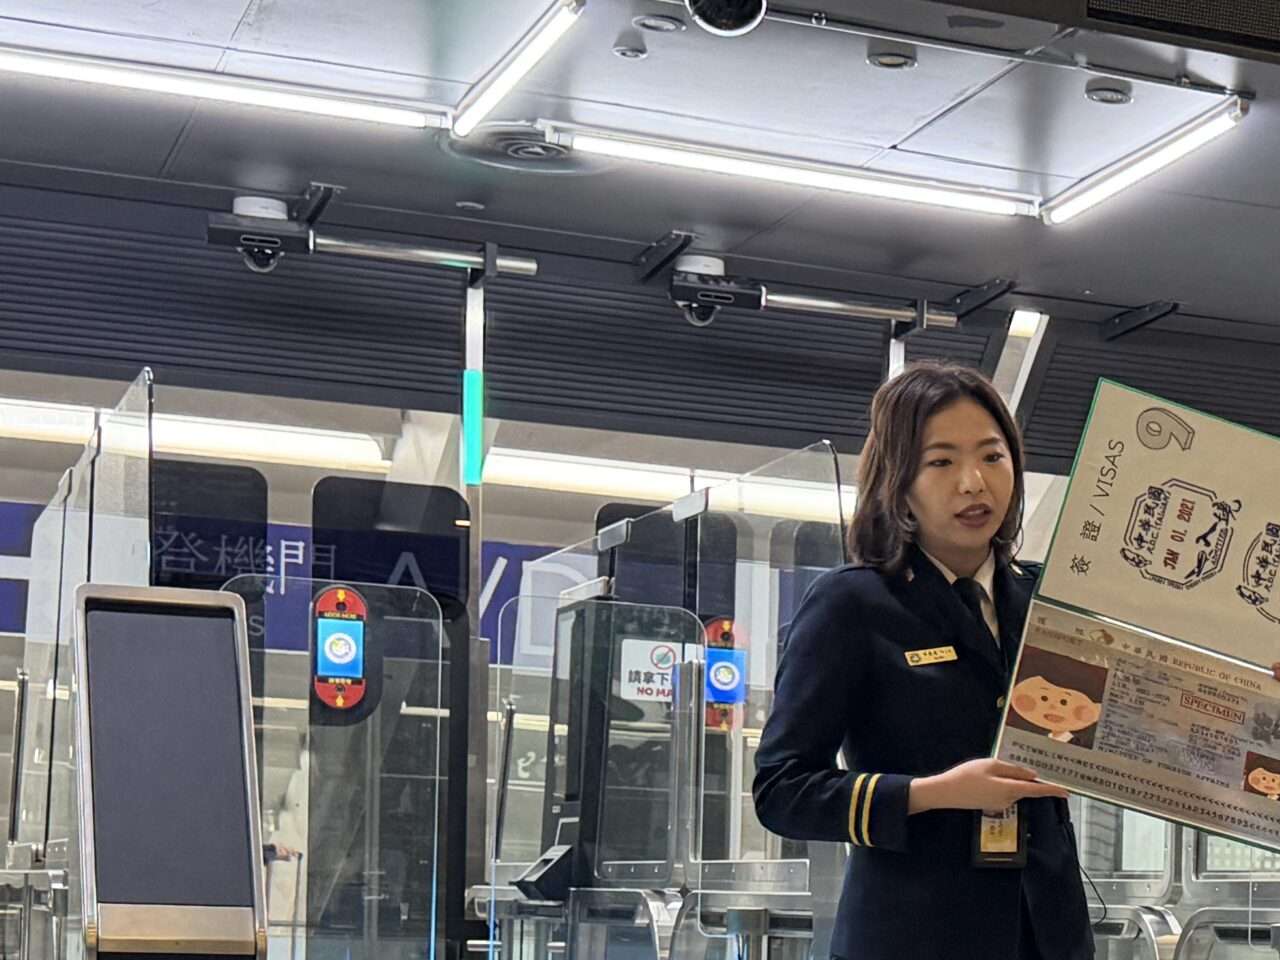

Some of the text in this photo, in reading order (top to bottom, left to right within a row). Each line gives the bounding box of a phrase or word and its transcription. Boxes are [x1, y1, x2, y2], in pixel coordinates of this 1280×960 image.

[1093, 439, 1125, 499] VISAS
[1163, 548, 1180, 570] JAN
[1177, 498, 1196, 523] 2021
[637, 687, 653, 696] NO
[1182, 696, 1244, 722] SPECIMEN
